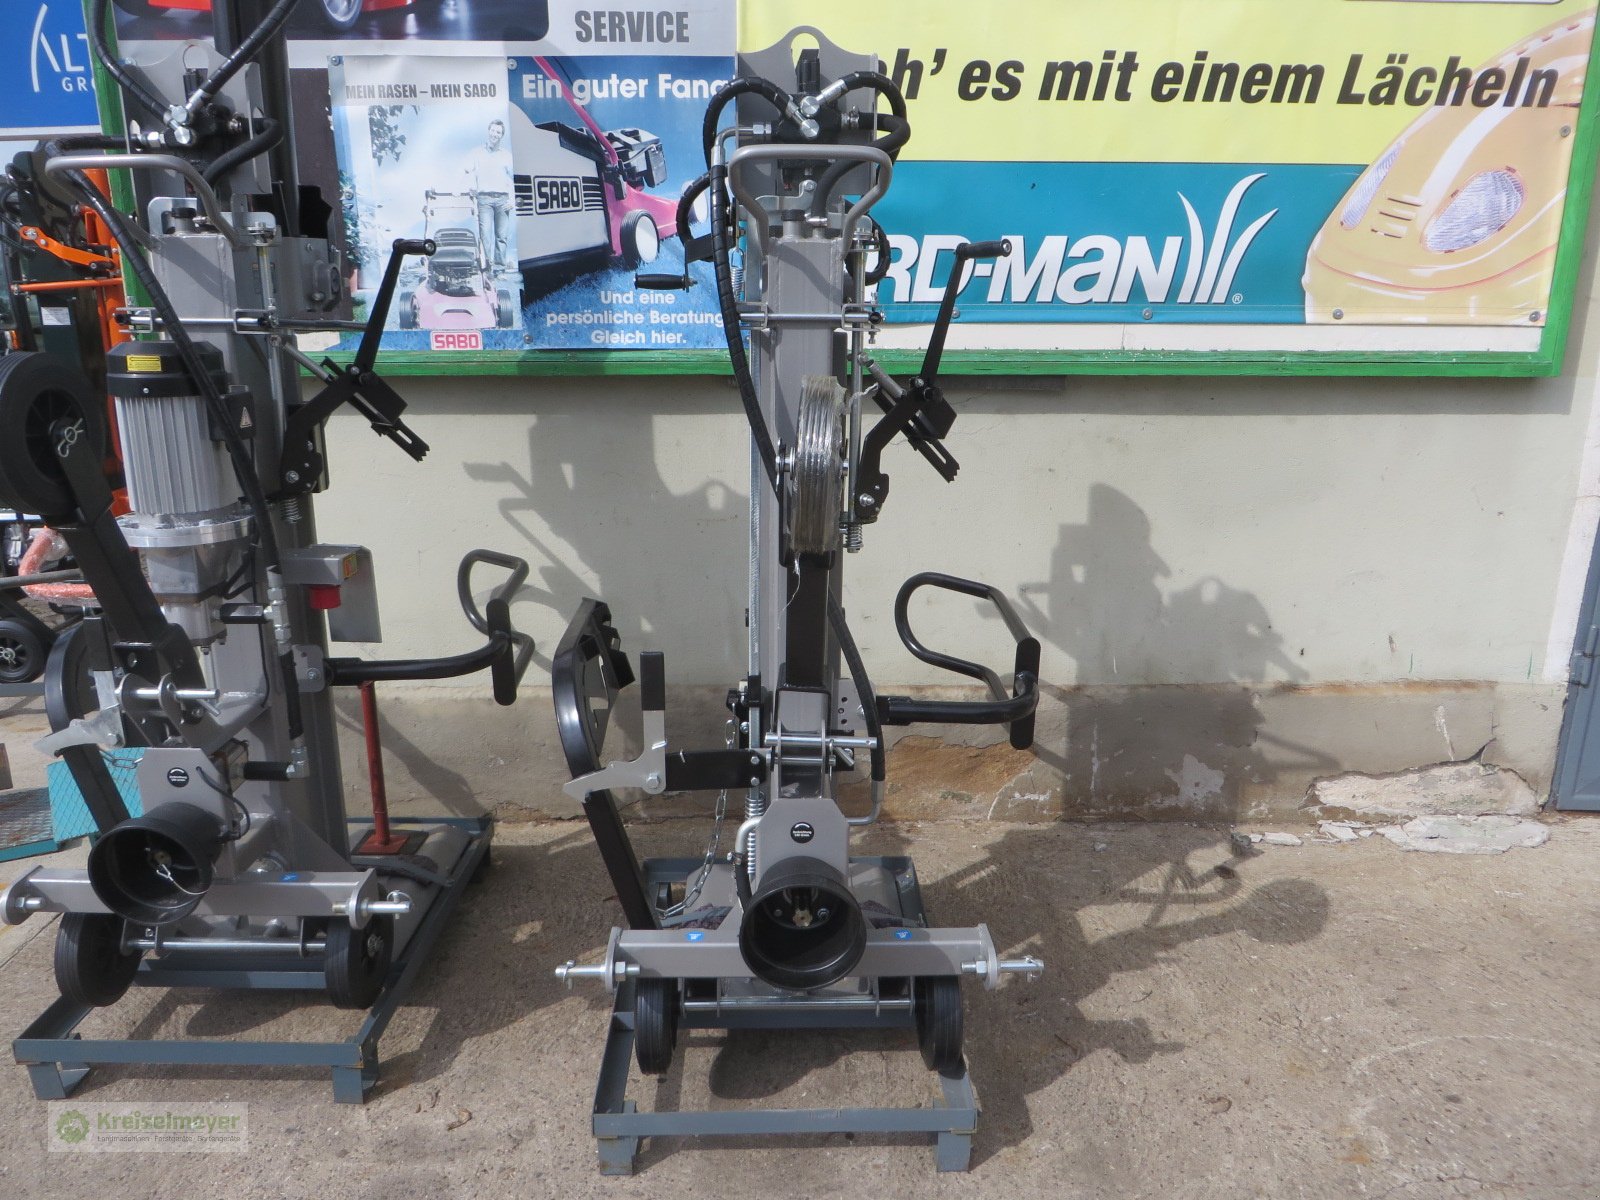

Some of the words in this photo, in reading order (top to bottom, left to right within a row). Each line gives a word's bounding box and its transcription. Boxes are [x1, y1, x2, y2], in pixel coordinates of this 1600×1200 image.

[574, 10, 690, 43] SERVICE
[61, 76, 96, 92] GR
[957, 59, 1025, 102] es
[1037, 49, 1139, 102] mit
[1150, 50, 1325, 104] einem
[1336, 53, 1559, 108] Lächeln
[345, 84, 375, 100] MEIN
[378, 84, 418, 98] RASEN
[430, 83, 461, 98] MEIN
[463, 83, 497, 98] SABO
[522, 74, 563, 99] Ein
[572, 73, 649, 106] guter
[537, 180, 581, 210] SABO
[600, 291, 634, 305] Und
[639, 291, 676, 305] eine
[546, 309, 645, 328] persönliche
[649, 310, 725, 328] Beratung
[434, 334, 479, 349] SABO
[591, 329, 647, 345] Gleich
[651, 330, 688, 344] hier.
